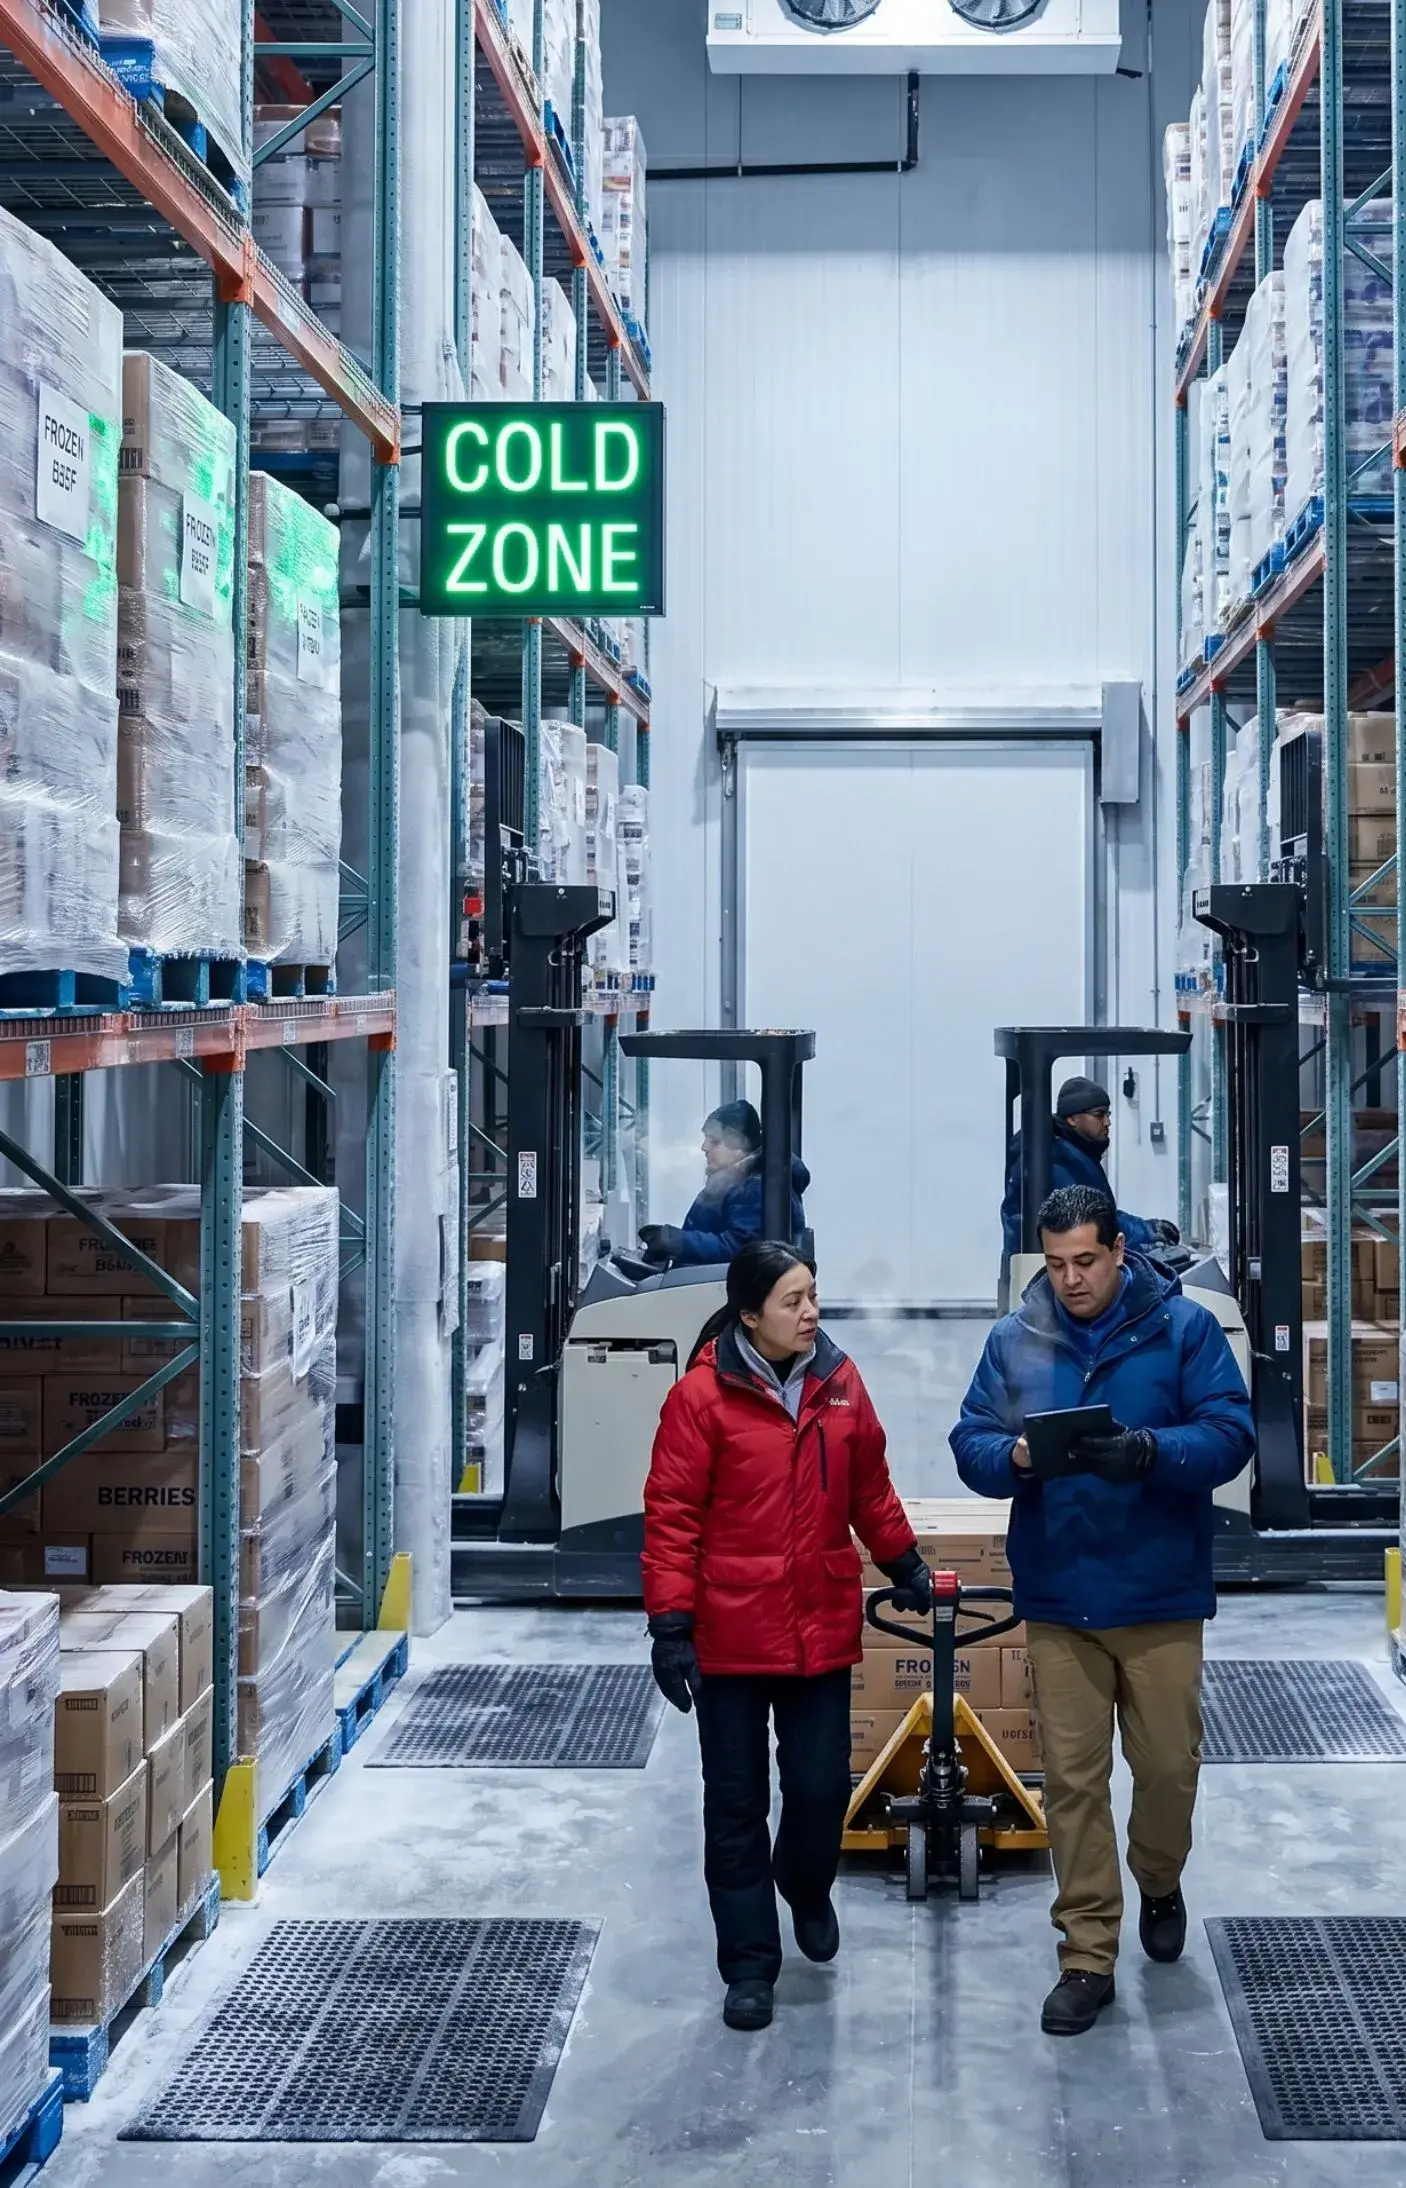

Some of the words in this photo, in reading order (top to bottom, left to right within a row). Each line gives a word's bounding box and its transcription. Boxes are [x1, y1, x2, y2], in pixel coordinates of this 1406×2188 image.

[44, 414, 84, 462] FROZEN
[445, 421, 640, 492] COLD
[445, 522, 639, 592] ZONE
[98, 1487, 196, 1506] BERRIES
